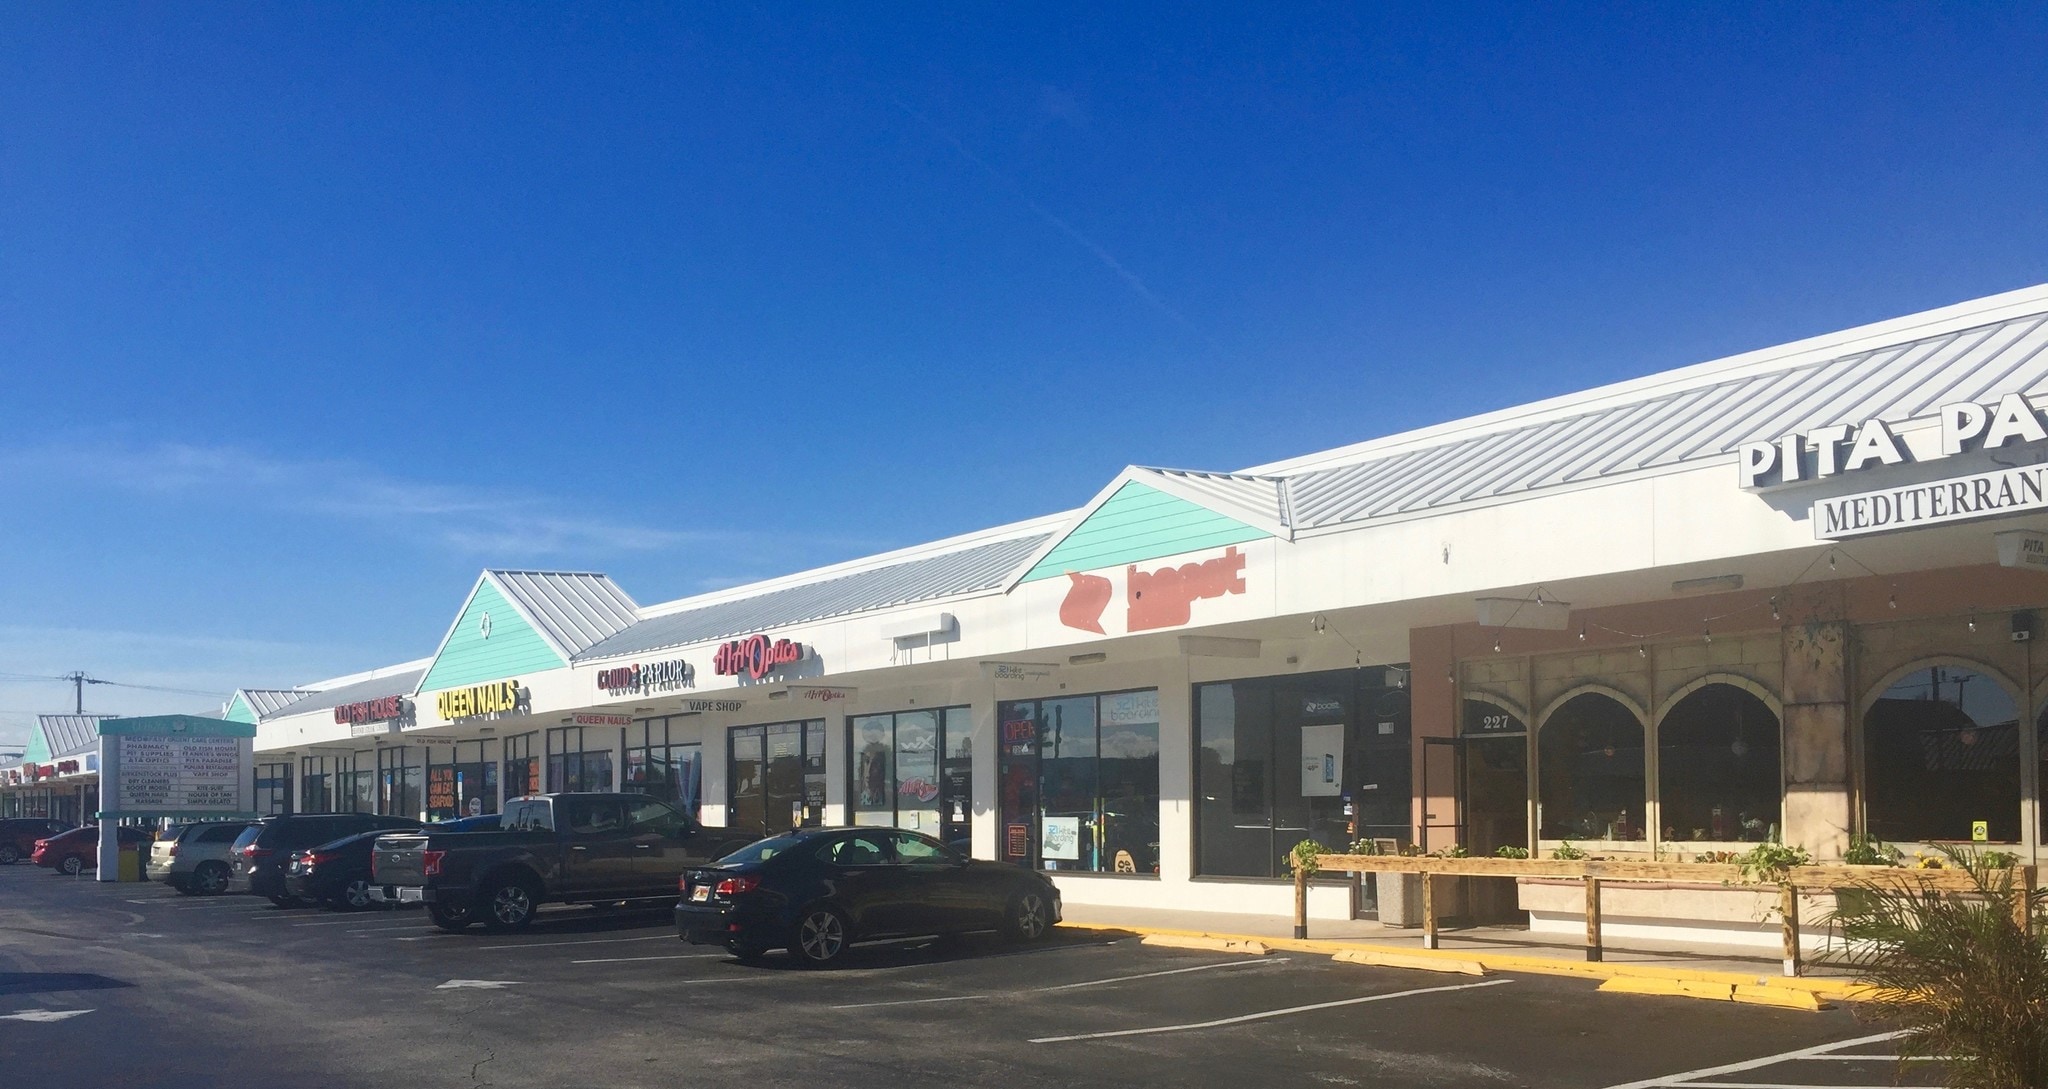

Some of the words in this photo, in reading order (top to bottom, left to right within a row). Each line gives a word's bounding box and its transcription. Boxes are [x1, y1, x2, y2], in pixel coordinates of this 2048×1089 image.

[1738, 418, 1903, 490] PITA
[1825, 467, 2048, 533] MEDITERRAN
[2022, 538, 2044, 553] PITA
[749, 634, 802, 679] Optics
[597, 667, 631, 690] CLOUD
[640, 659, 685, 685] PARLOR
[995, 671, 1024, 681] boarding
[998, 665, 1008, 673] 321
[437, 687, 474, 720] QUEEN
[477, 680, 518, 713] NAILS
[689, 701, 713, 712] VAPE
[716, 701, 742, 712] SHOP
[1317, 701, 1340, 710] boost
[334, 705, 349, 724] OLD
[351, 702, 367, 723] FISH
[370, 695, 402, 718] HOUSE
[1111, 709, 1159, 721] boardin
[576, 714, 605, 725] QUEEN
[607, 715, 632, 726] NAILS
[1483, 715, 1509, 729] 227
[1006, 720, 1035, 740] OPEN
[430, 768, 442, 782] ALL
[429, 794, 454, 808] SEAFOOD
